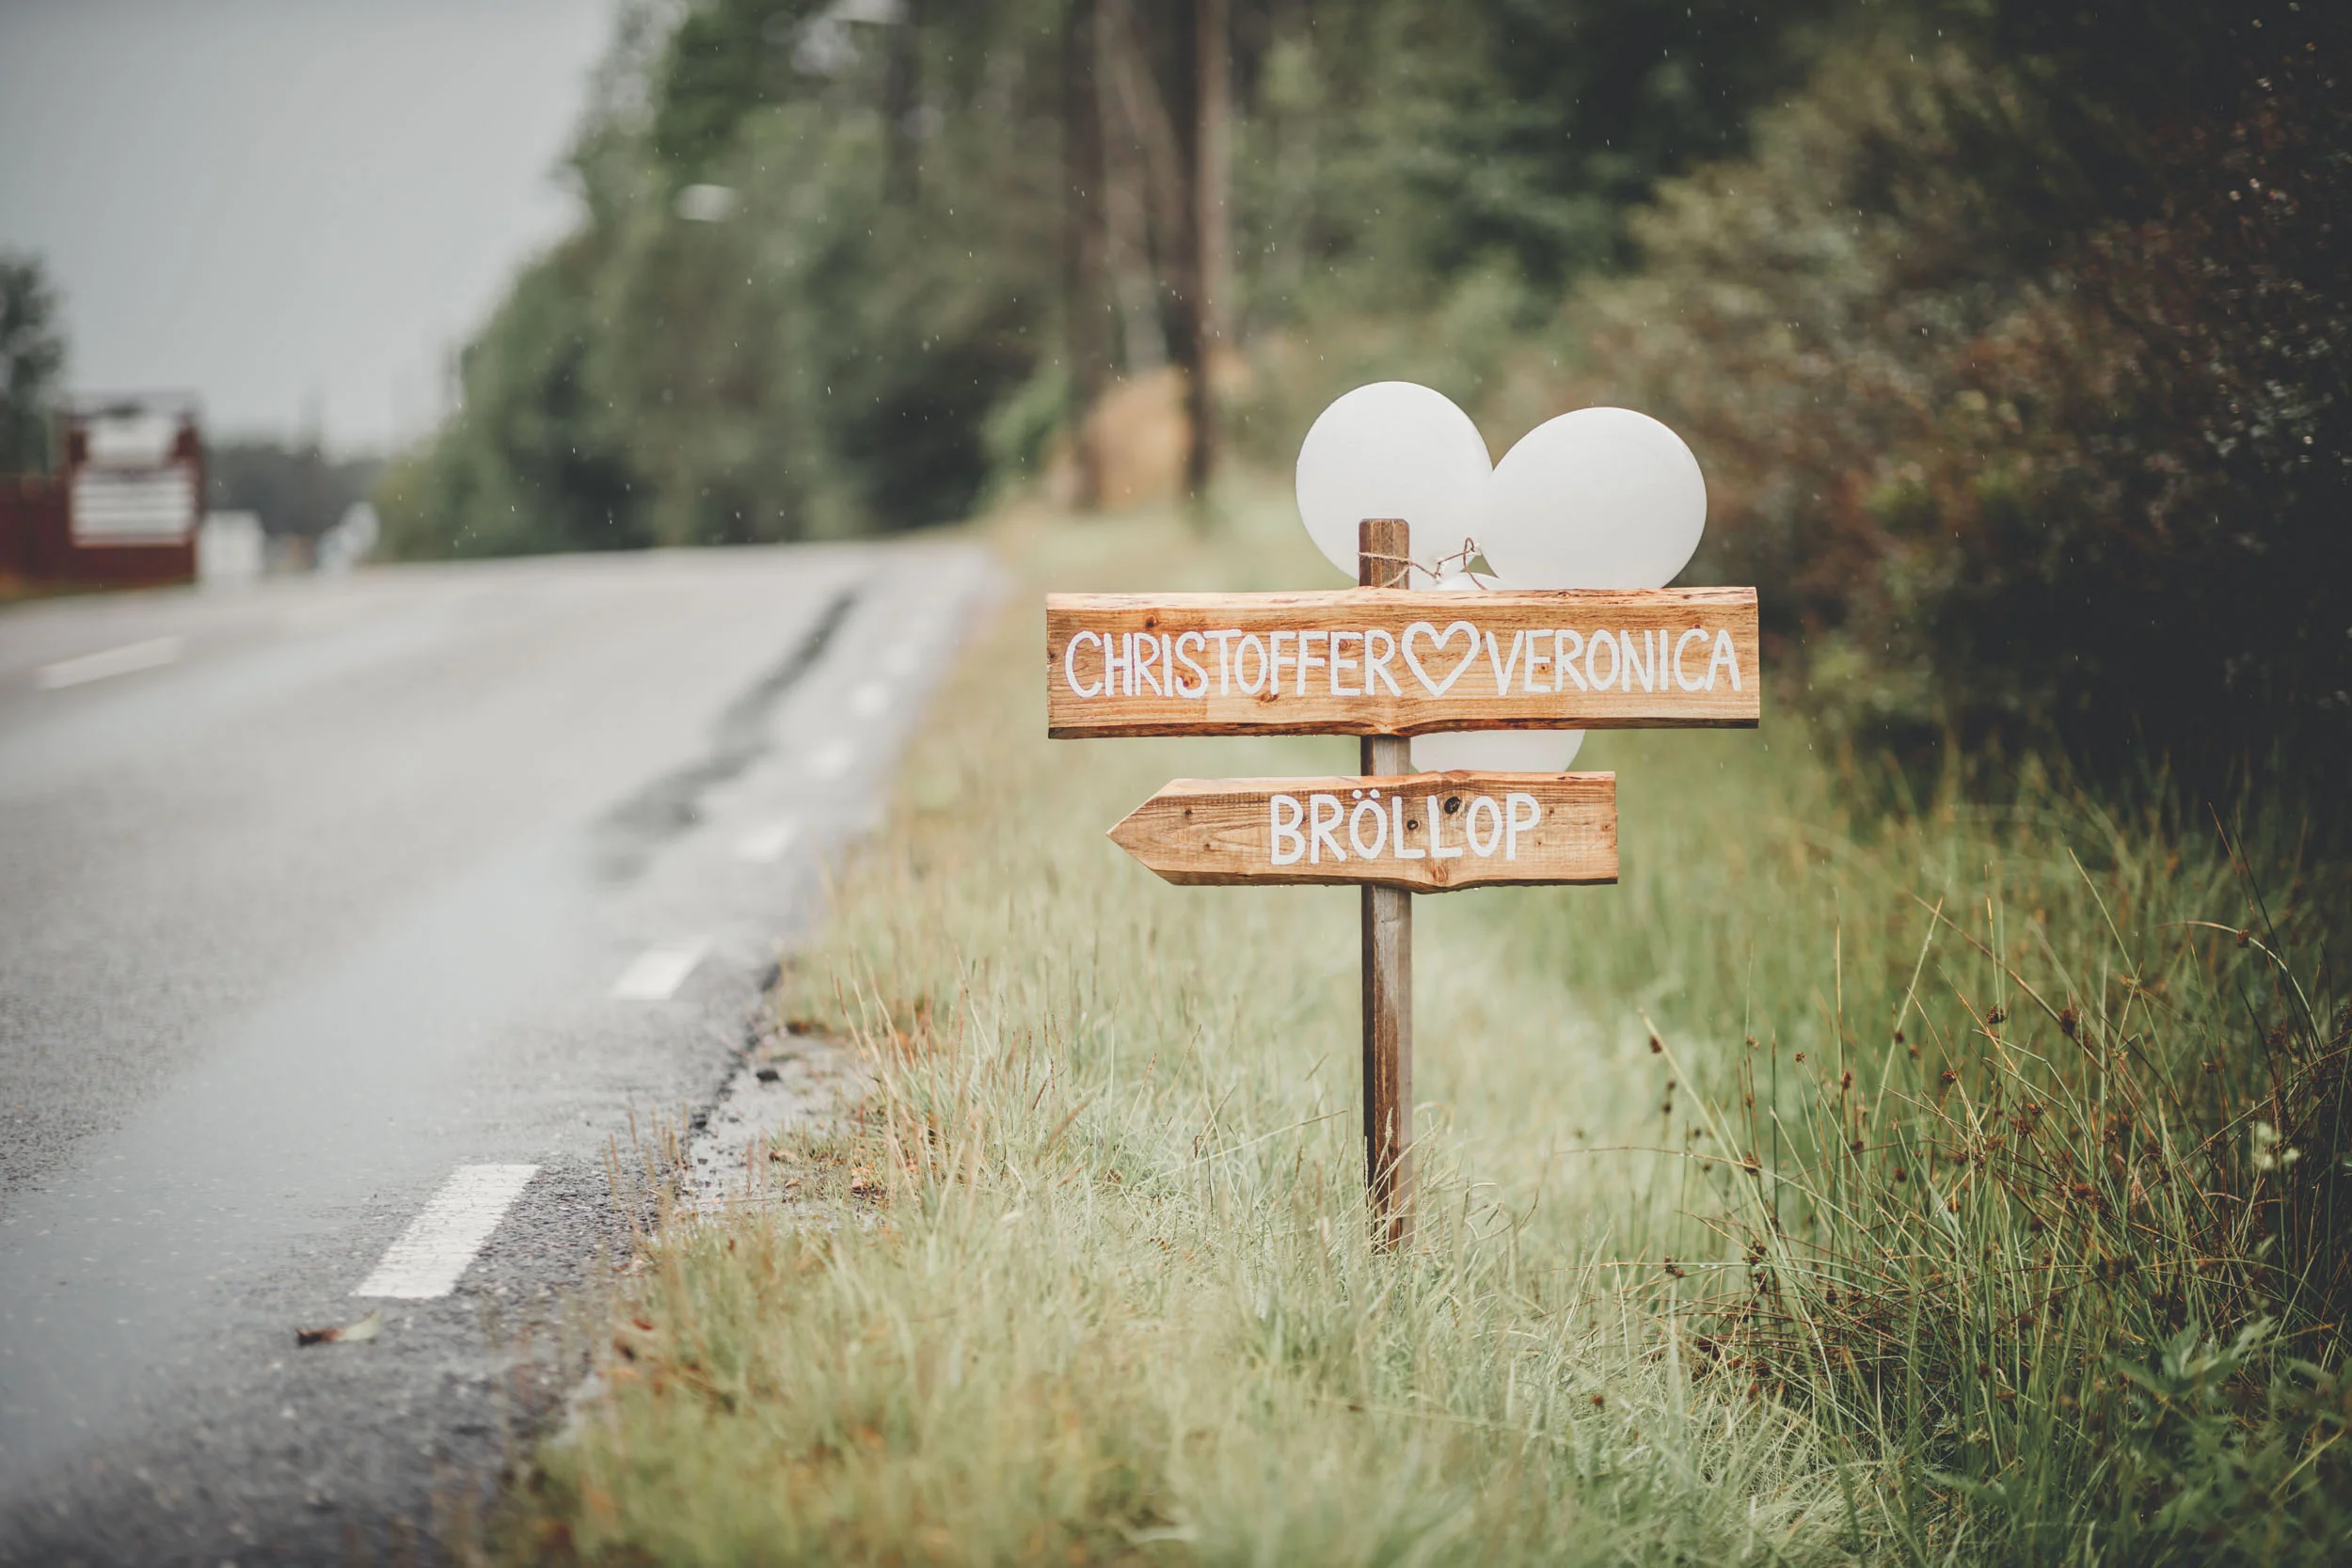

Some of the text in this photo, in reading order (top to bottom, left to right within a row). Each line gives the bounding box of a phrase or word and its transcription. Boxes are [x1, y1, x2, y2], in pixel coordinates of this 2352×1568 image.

[1065, 628, 1740, 698] CHRISTOFFER VERONICA
[1270, 789, 1541, 865] BRÖLLOP
